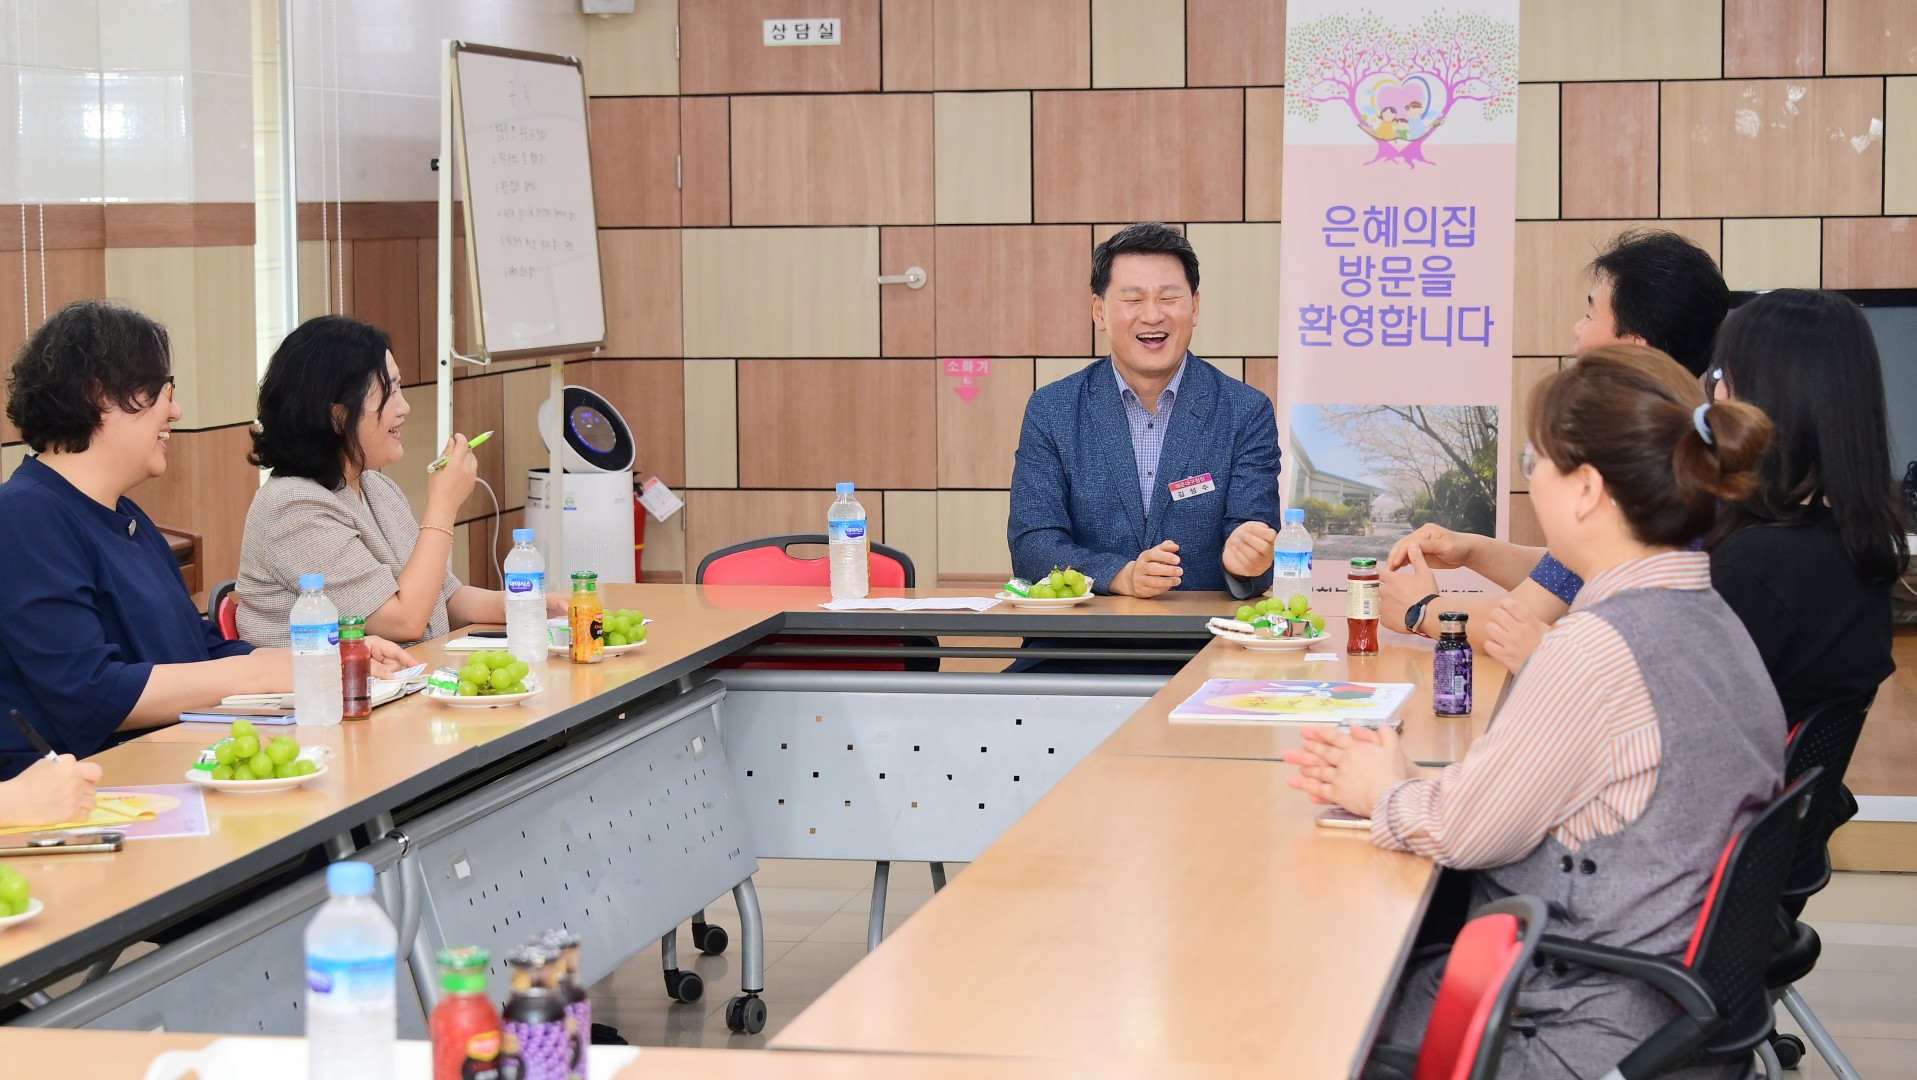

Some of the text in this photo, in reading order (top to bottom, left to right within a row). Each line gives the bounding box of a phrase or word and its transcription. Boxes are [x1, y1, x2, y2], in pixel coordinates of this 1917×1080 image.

[771, 22, 834, 41] 상담실
[1321, 204, 1477, 248] 은혜의집
[1338, 254, 1456, 298] 방문을
[1297, 303, 1495, 348] 환영합니다
[946, 359, 989, 374] 소화기
